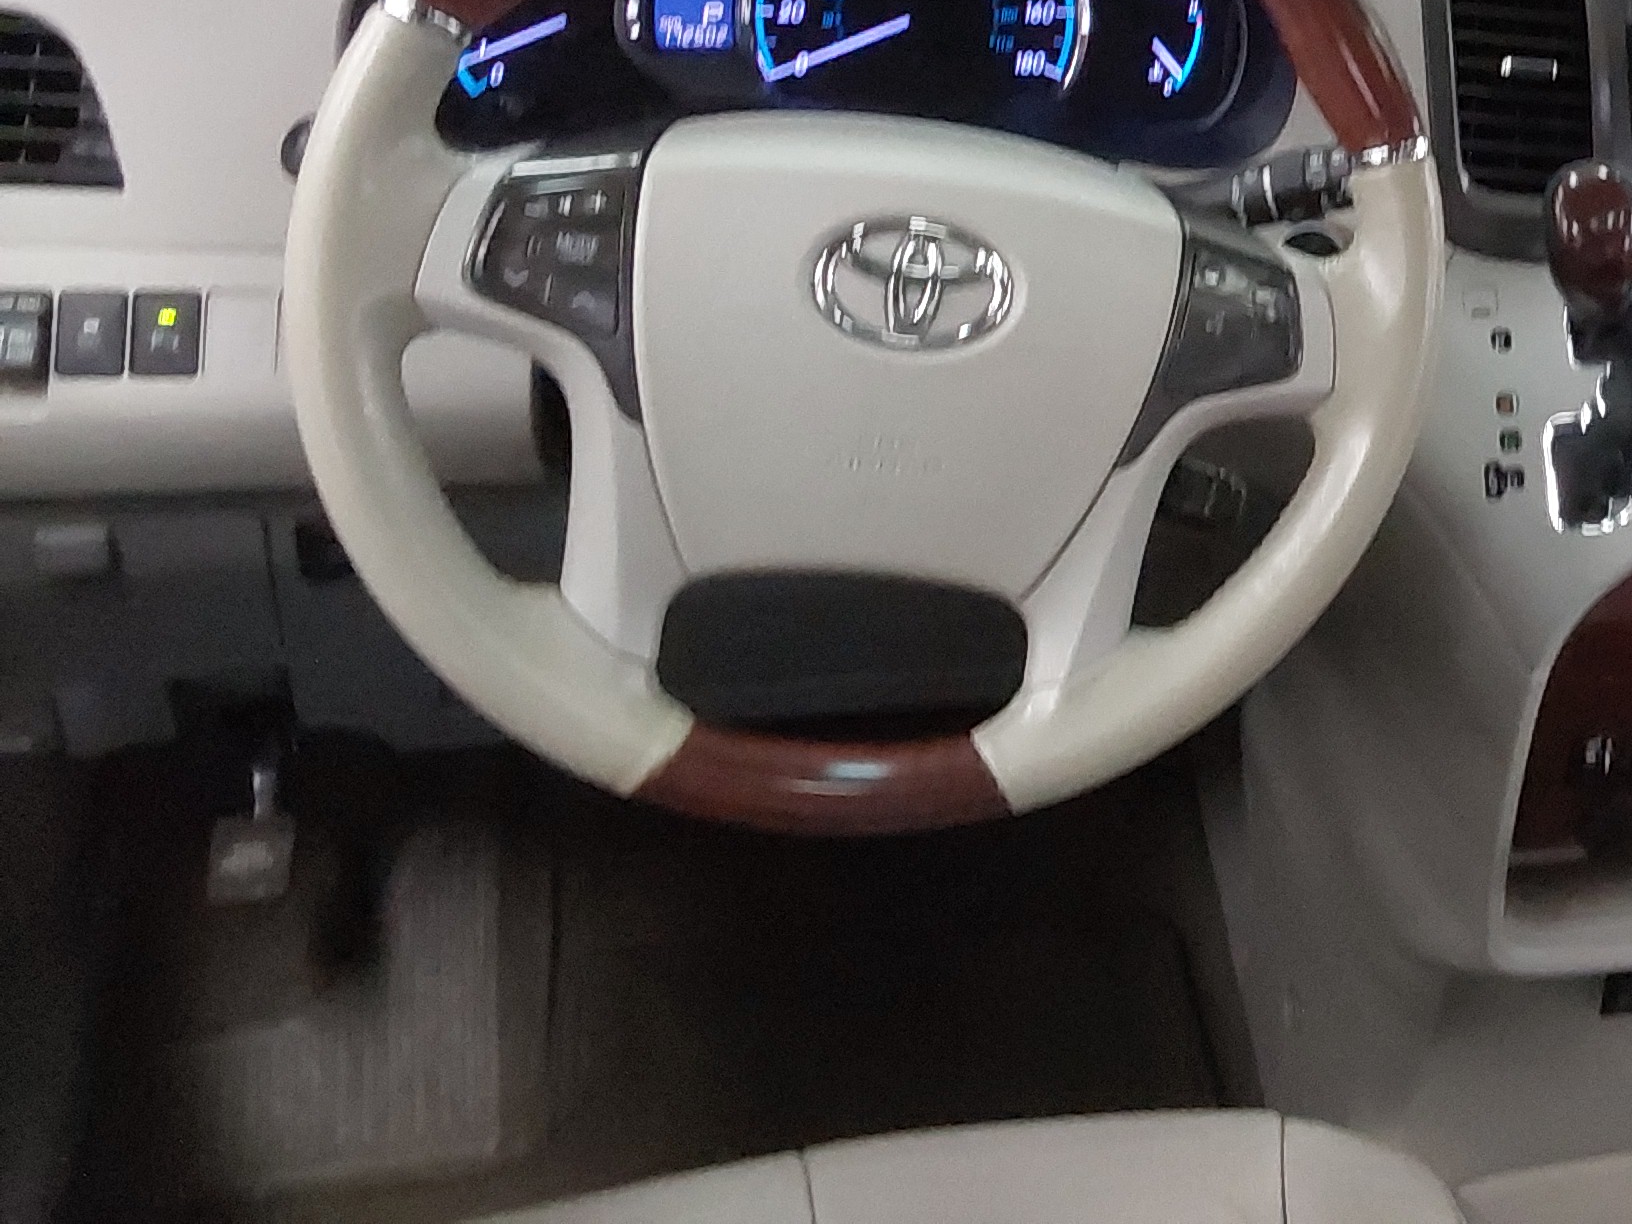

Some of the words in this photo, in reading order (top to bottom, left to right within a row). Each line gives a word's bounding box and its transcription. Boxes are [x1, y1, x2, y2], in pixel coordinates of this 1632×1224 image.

[1024, 0, 1056, 26] 160
[490, 61, 505, 88] 0
[1014, 49, 1046, 76] 180
